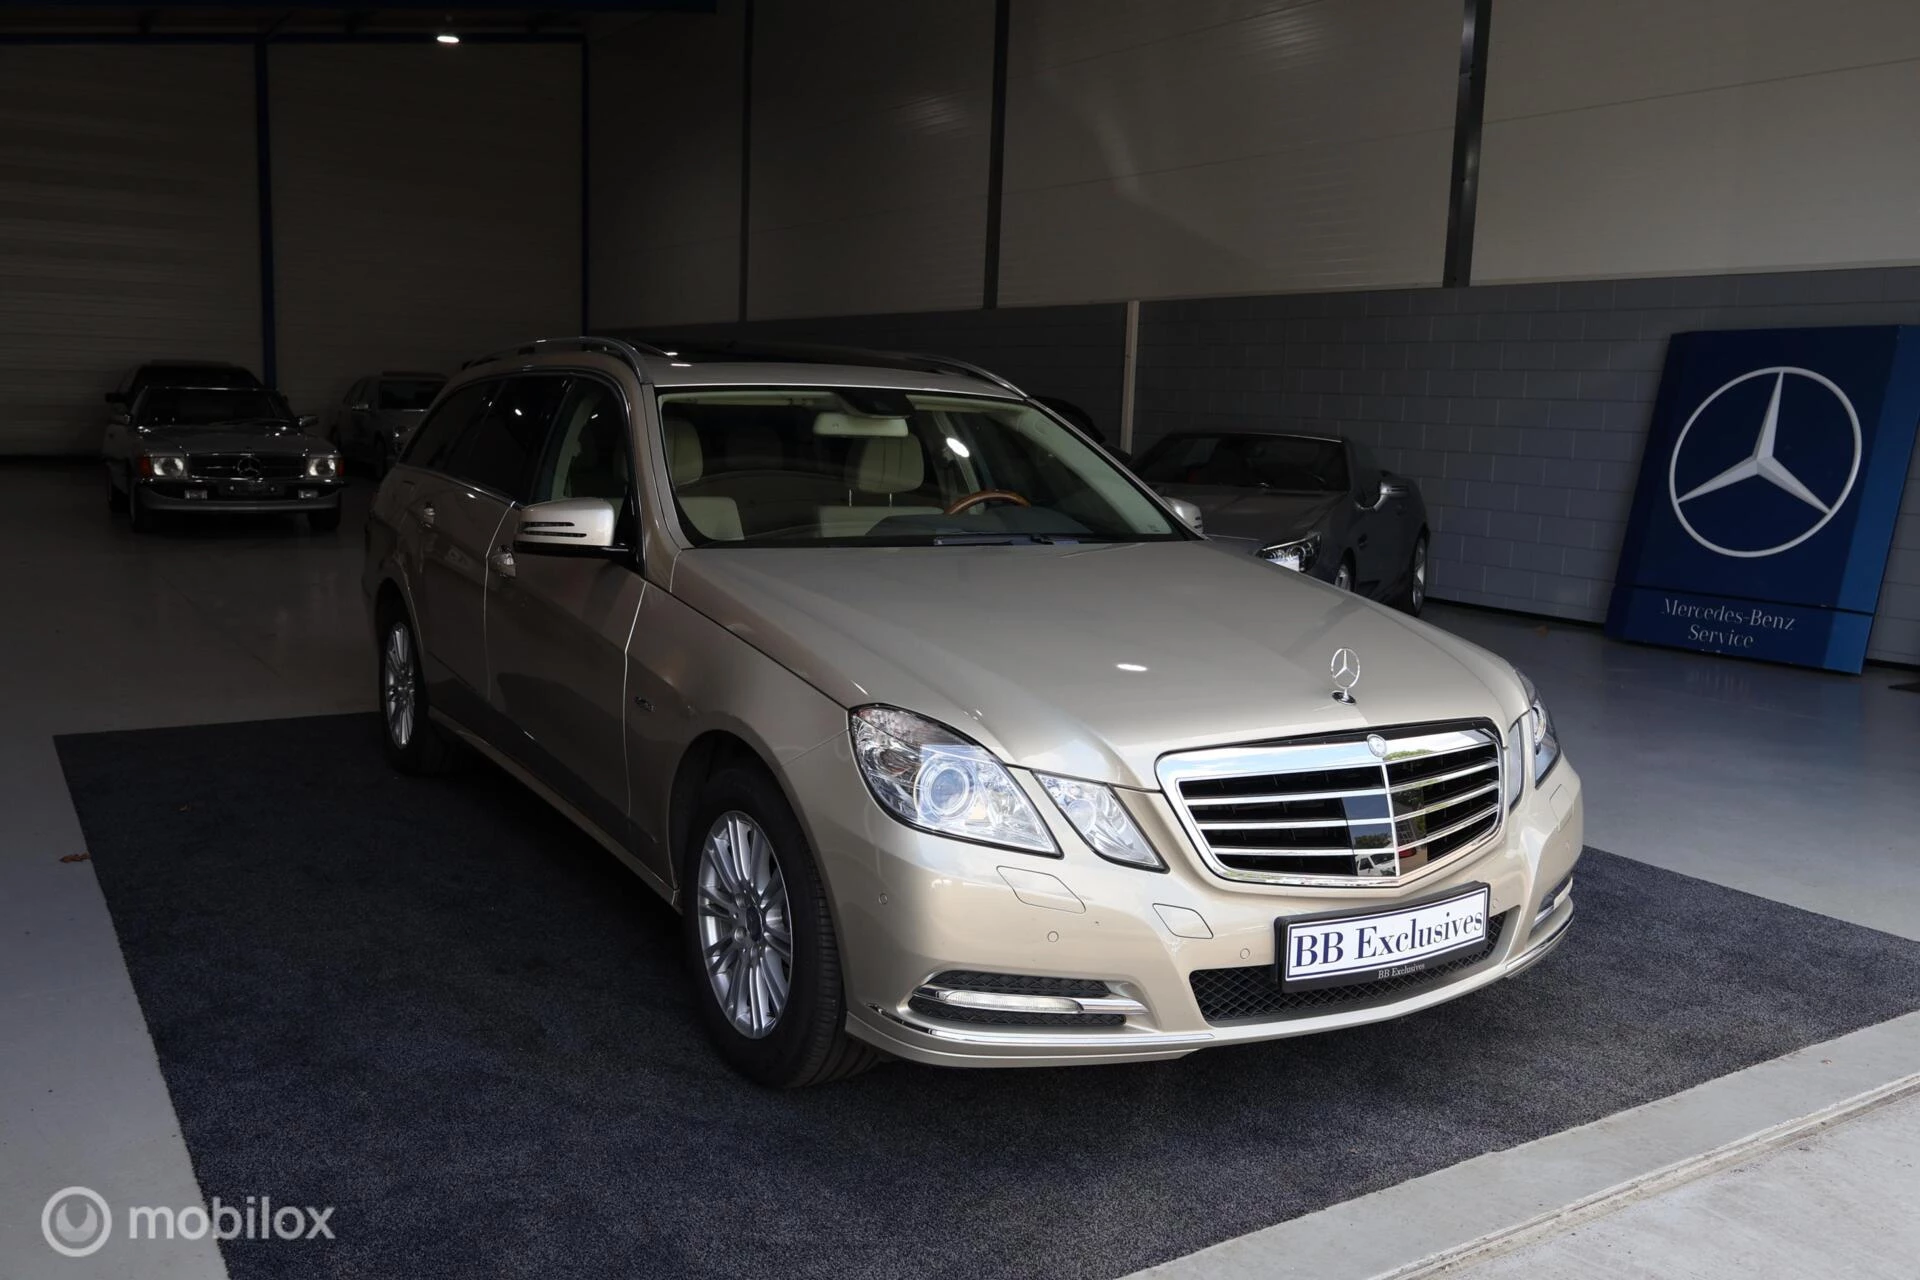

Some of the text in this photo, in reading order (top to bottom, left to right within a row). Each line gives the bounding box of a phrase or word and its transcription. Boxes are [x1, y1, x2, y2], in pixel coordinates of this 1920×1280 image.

[1661, 598, 1797, 631] Mercedes-Benz
[1687, 624, 1755, 649] Service
[1292, 911, 1483, 969] BB Exclusives
[1378, 962, 1426, 980] BB Exclusives
